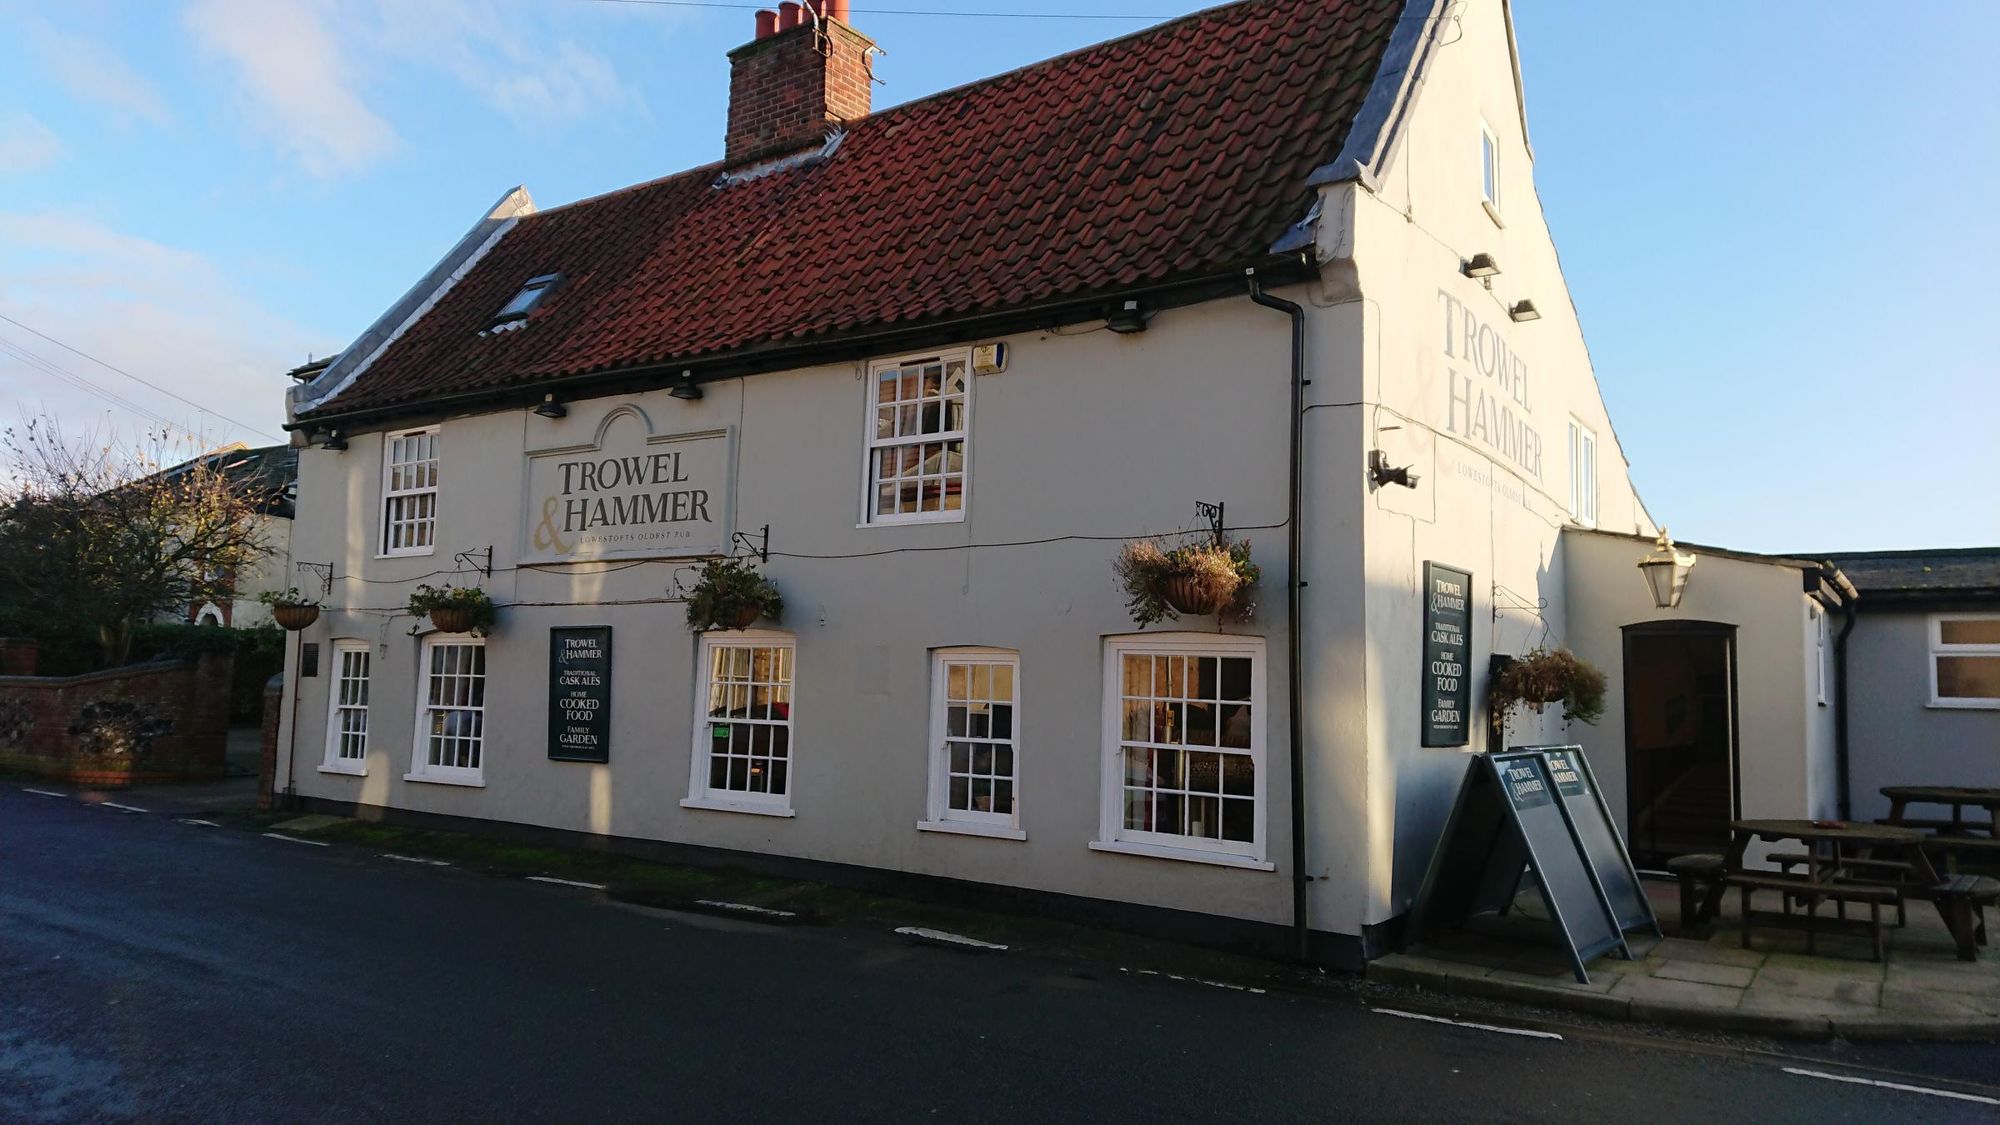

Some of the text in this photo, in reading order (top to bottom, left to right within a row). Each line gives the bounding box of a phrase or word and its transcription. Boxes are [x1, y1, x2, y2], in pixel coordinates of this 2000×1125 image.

[1437, 287, 1533, 415] TROWEL
[1446, 366, 1544, 486] HAMMER
[558, 452, 689, 495] TROWEL
[1457, 461, 1501, 494] LOWESTOTS
[533, 489, 712, 554] & HAMMER
[637, 531, 671, 541] OLDEST
[674, 530, 691, 538] PUB
[1436, 579, 1462, 597] TROWEL
[1437, 594, 1465, 612] HAMMER
[565, 638, 598, 649] TROWEL
[1431, 630, 1464, 646] CASK ALES
[566, 649, 602, 660] HAMMER
[1440, 651, 1454, 661] HOME
[1432, 661, 1462, 677] COOKED
[560, 676, 601, 686] CASK ALES
[1437, 677, 1458, 692] FOOD
[560, 699, 599, 710] COOKED
[1438, 699, 1456, 709] FAMILY
[566, 710, 593, 721] FOOD
[1431, 710, 1460, 723] GARDEN
[567, 726, 590, 735] FAMILY
[560, 734, 598, 745] GARDEN
[1550, 760, 1570, 771] OWEL
[1508, 767, 1535, 782] TROWEL
[1553, 771, 1579, 783] AMMER
[1515, 780, 1544, 796] HAMMER
